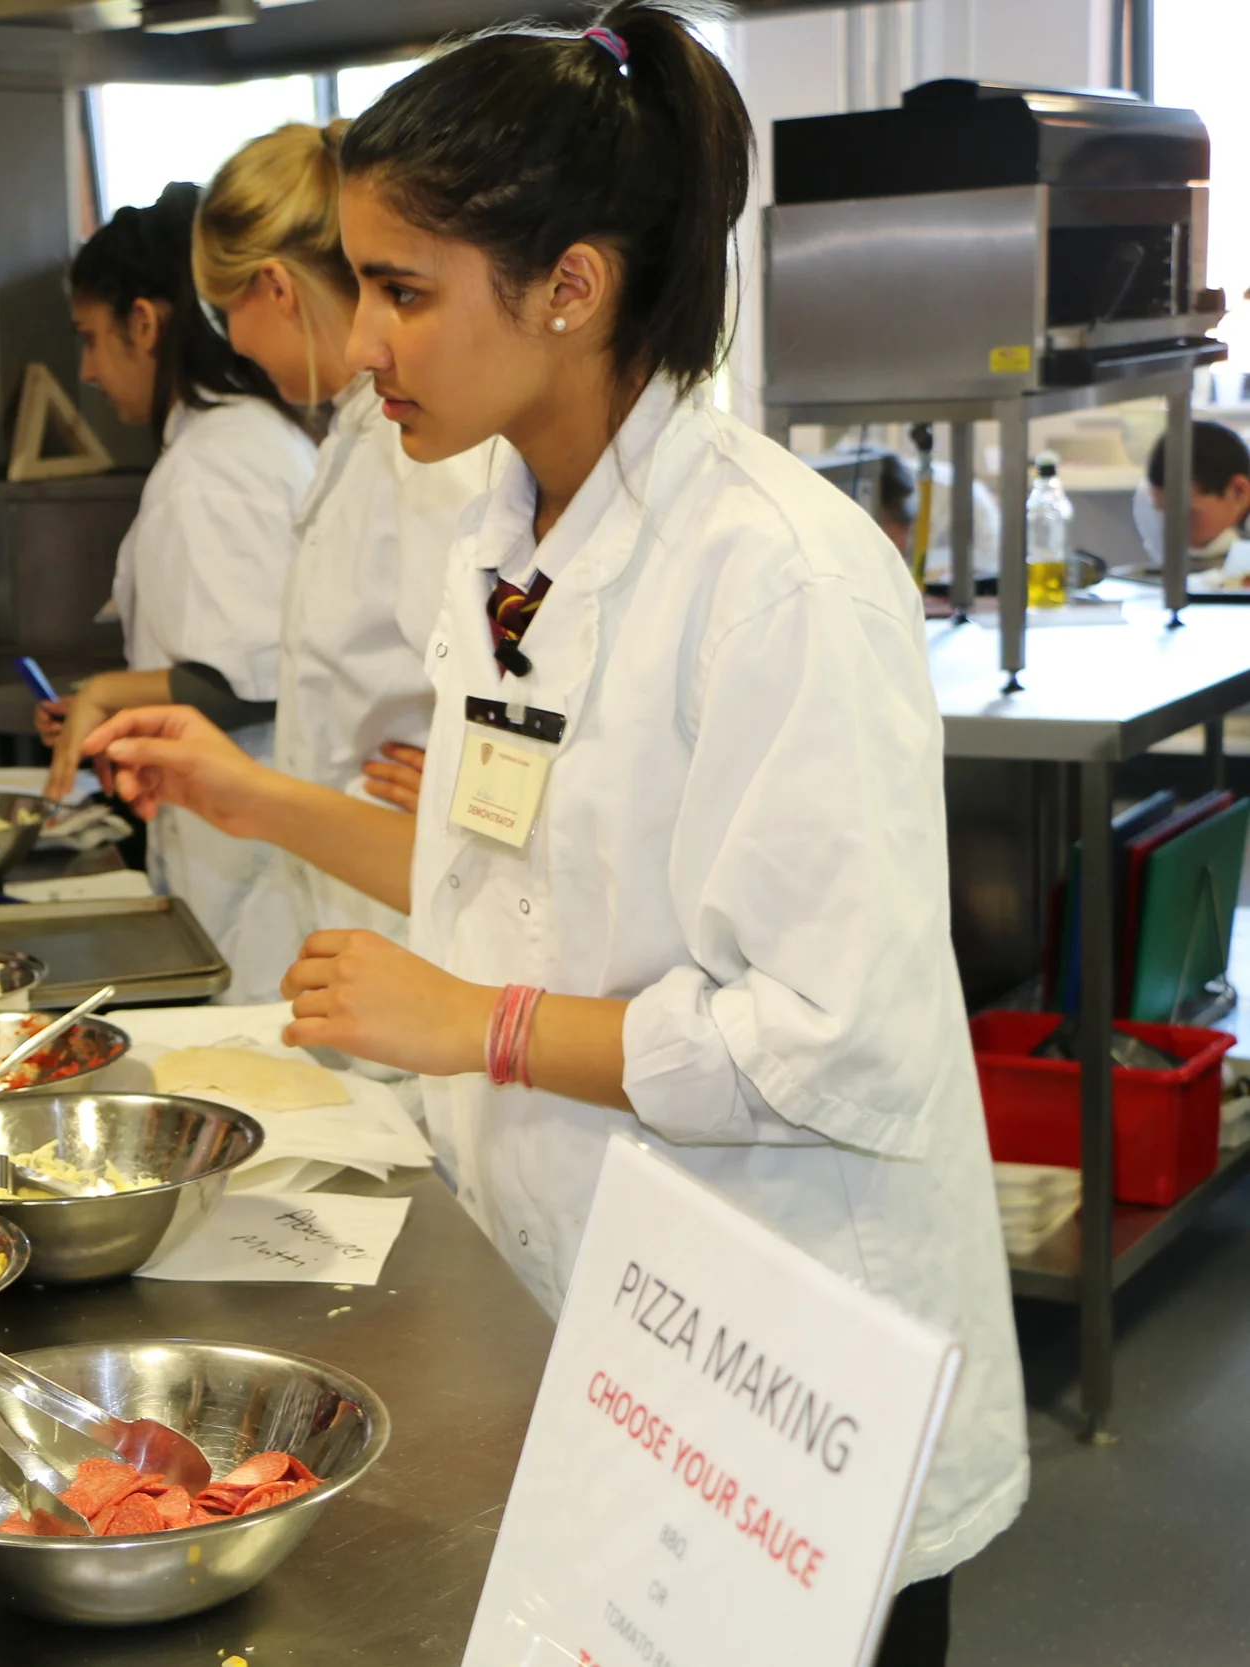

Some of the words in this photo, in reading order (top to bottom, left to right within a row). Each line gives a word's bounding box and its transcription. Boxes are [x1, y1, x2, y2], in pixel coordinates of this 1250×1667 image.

[467, 804, 515, 828] DEMONSTRATOR
[614, 1260, 701, 1364] PIZZA
[701, 1326, 859, 1475] MAKING
[587, 1370, 673, 1461] CHOOSE
[672, 1437, 739, 1519] YOUR
[735, 1495, 826, 1590] SAUCE
[658, 1523, 687, 1561] BBQ
[648, 1579, 668, 1608] OR
[603, 1600, 654, 1662] TOMATO
